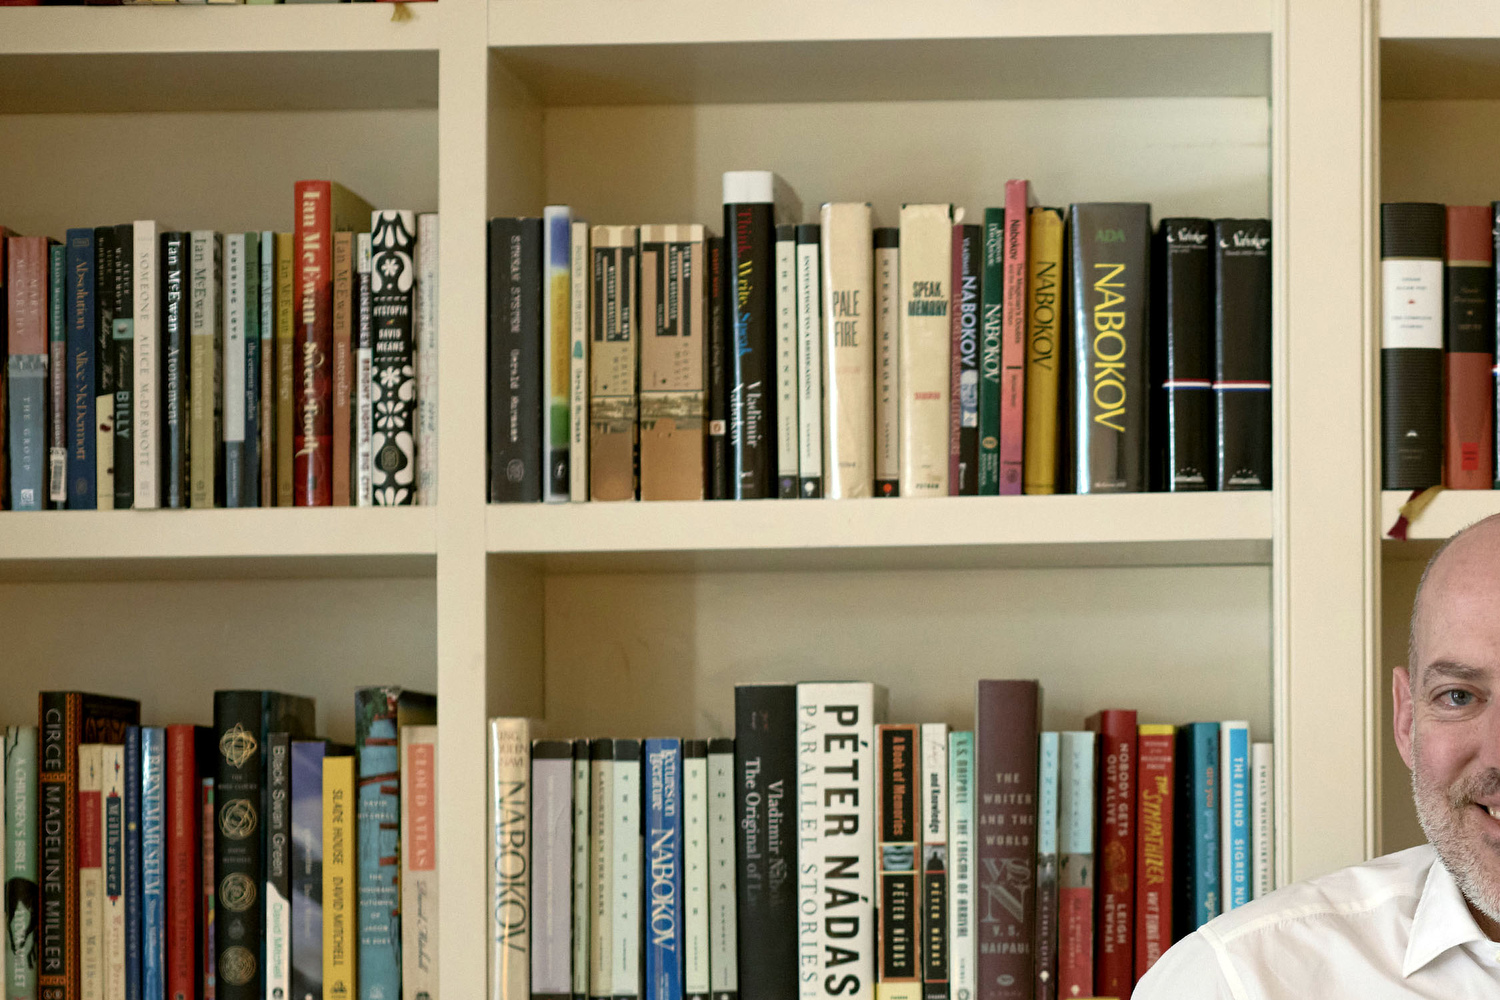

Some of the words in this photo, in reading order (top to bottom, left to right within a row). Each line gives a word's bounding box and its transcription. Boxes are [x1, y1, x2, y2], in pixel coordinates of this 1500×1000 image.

[302, 190, 320, 227] Ian
[168, 241, 180, 264] Ian
[194, 238, 206, 260] Ian
[1009, 218, 1020, 260] Nabokov
[140, 252, 149, 321] SOMEONE
[168, 270, 181, 333] McEwan
[194, 267, 207, 329] McEwan
[833, 290, 860, 317] PALE
[834, 321, 859, 347] FIRE
[961, 277, 976, 366] NABOKOV
[1033, 261, 1056, 371] NABOKOV
[140, 334, 149, 375] ALICE
[983, 304, 1000, 382] NABOKOV
[1094, 263, 1126, 433] NABOKOV
[167, 346, 179, 425] Atonement
[116, 391, 129, 439] BILLY
[746, 382, 762, 448] Vladimir
[44, 708, 61, 770] CIRCE
[272, 745, 286, 786] Black
[415, 747, 429, 806] CLOUD
[747, 757, 760, 789] The
[801, 705, 817, 850] PARALLEL
[824, 705, 868, 837] PÉTER
[931, 773, 941, 788] and
[996, 774, 1020, 783] THE
[1106, 755, 1117, 782] OUT
[1119, 743, 1130, 798] NOBODY
[1156, 775, 1168, 795] THE
[1234, 757, 1244, 780] THE
[272, 789, 285, 830] Swan
[333, 790, 344, 824] SLADE
[769, 780, 783, 854] Vladimir
[893, 785, 905, 836] Memories
[980, 815, 1004, 824] AND
[983, 794, 1032, 804] WRITER
[1106, 786, 1116, 824] ALIVE
[1204, 789, 1213, 808] you
[1234, 784, 1244, 827] FRIEND
[45, 786, 62, 892] MADELINE
[415, 812, 429, 867] ATLAS
[742, 792, 760, 859] Original
[957, 819, 968, 836] THE
[985, 836, 1029, 846] WORLD
[1119, 803, 1130, 837] GETS
[1143, 789, 1164, 886] SYMPATHIZER
[14, 838, 26, 871] BIBLE
[272, 834, 285, 876] Green
[333, 828, 344, 865] HOUSE
[495, 781, 526, 952] NABOKOV
[1235, 838, 1245, 881] SIGRID
[652, 828, 674, 952] NABOKOV
[747, 863, 759, 881] of
[333, 877, 344, 913] DAVID
[44, 901, 62, 971] MILLER
[273, 903, 285, 934] David
[801, 864, 817, 983] STORIES
[824, 855, 868, 996] NÁDAS
[1105, 894, 1115, 953] NEWMAN
[1117, 903, 1127, 943] LEIGH
[273, 938, 285, 979] Mitchell
[333, 914, 344, 966] MITCHELL
